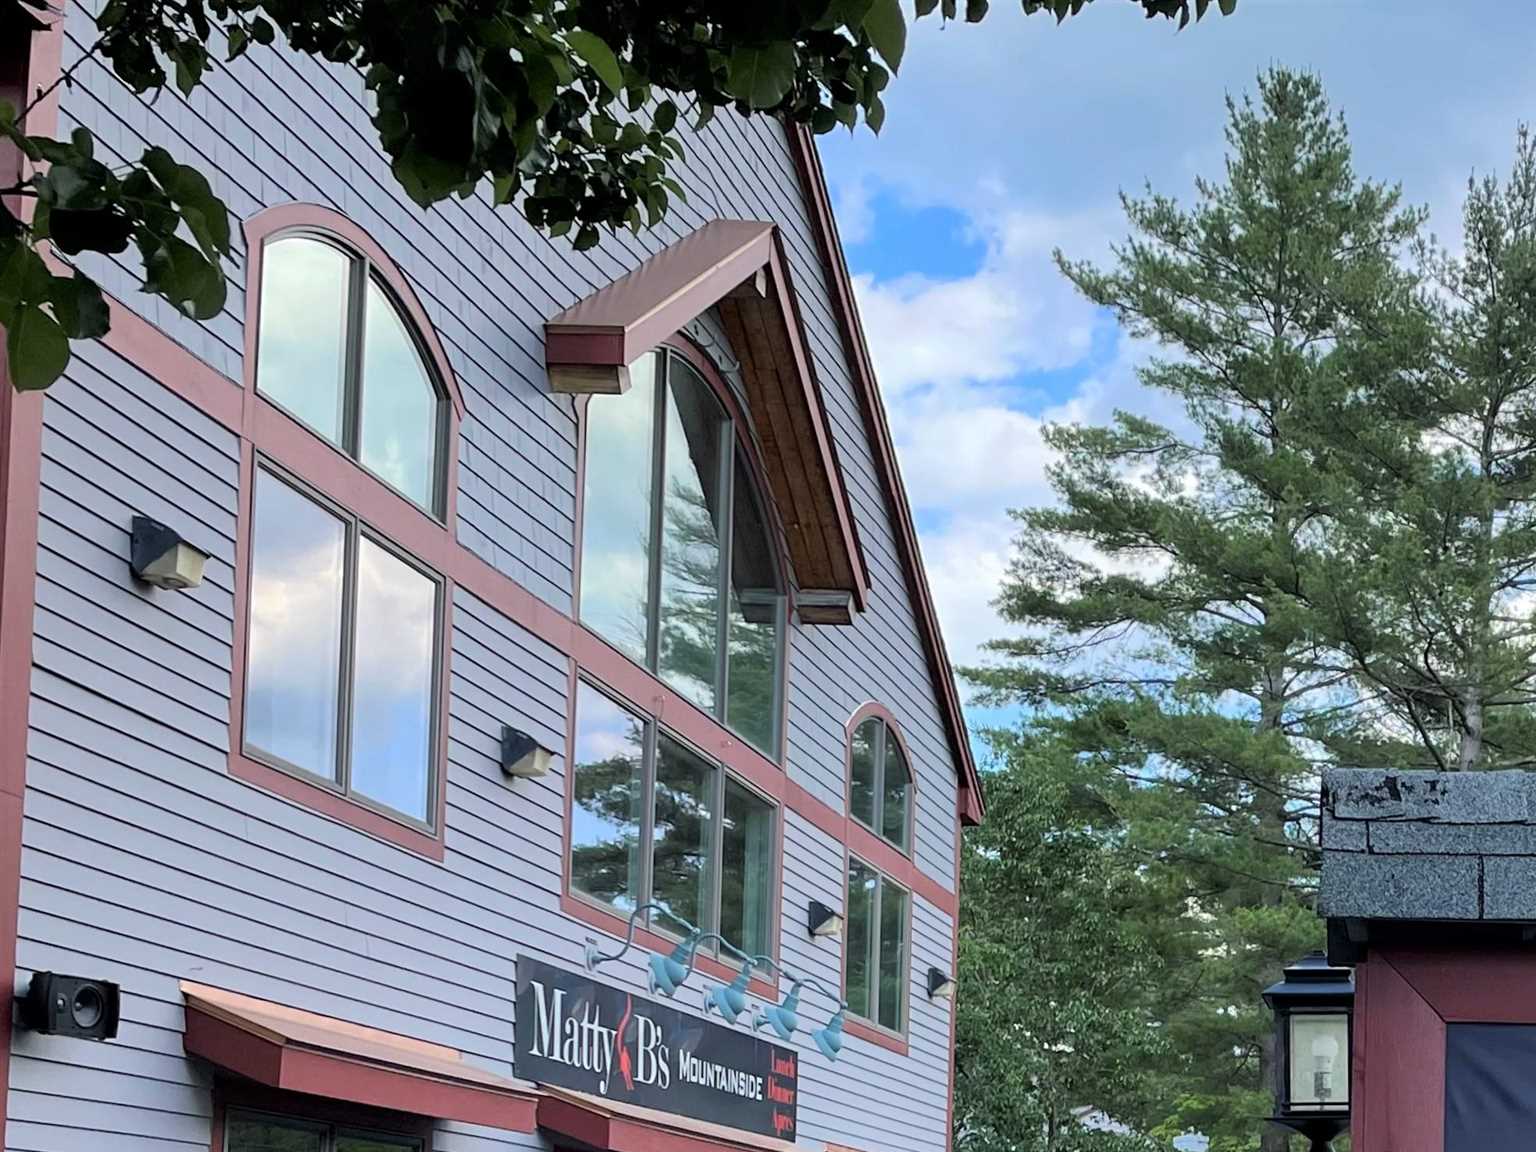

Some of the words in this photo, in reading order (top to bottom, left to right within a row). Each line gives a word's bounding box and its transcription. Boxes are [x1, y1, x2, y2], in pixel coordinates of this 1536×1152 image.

[528, 980, 617, 1095] Matty
[633, 1014, 671, 1090] B's
[679, 1049, 763, 1101] MOUNTAINSIDE
